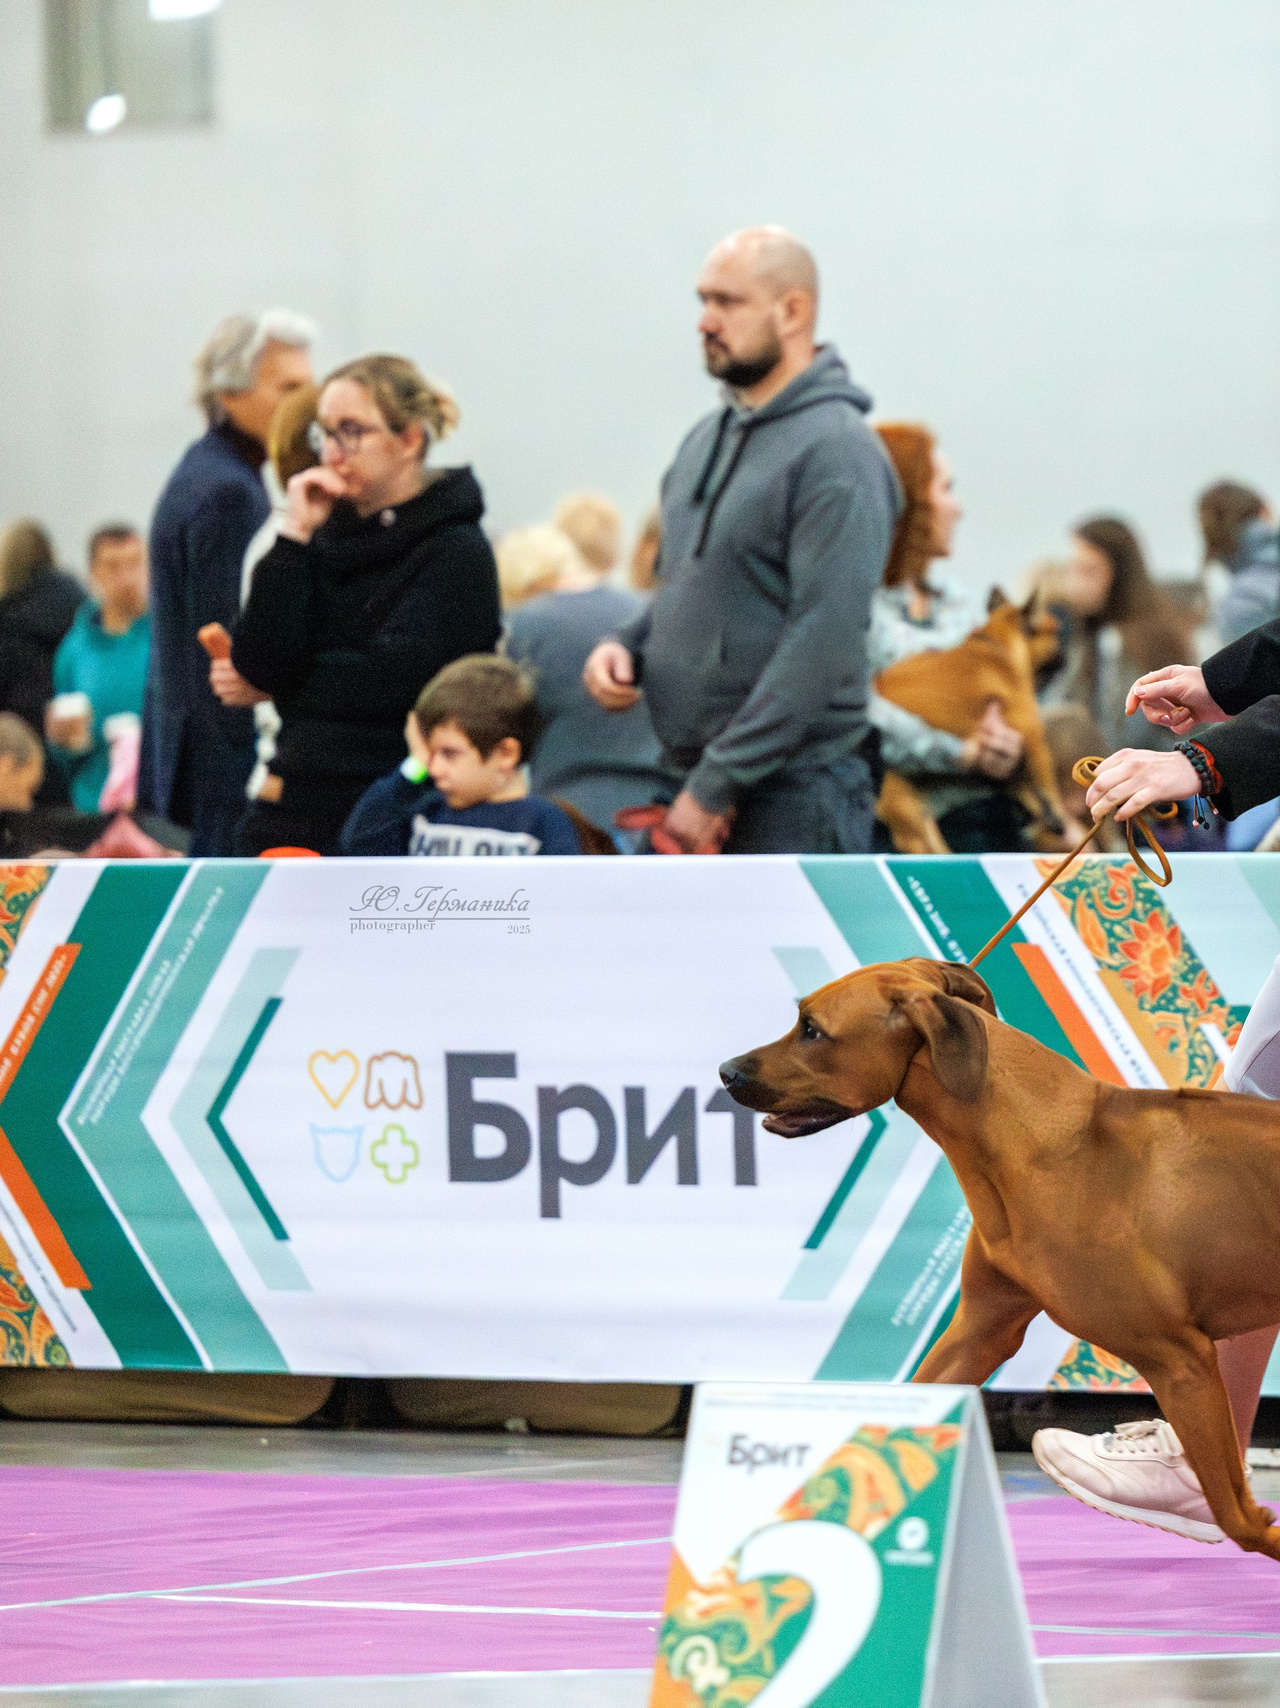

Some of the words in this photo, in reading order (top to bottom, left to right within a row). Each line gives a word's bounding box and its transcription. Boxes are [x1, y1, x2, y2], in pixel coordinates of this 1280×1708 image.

[444, 1050, 758, 1219] Брит
[726, 1433, 812, 1473] Брит
[737, 1520, 882, 1708] 2
